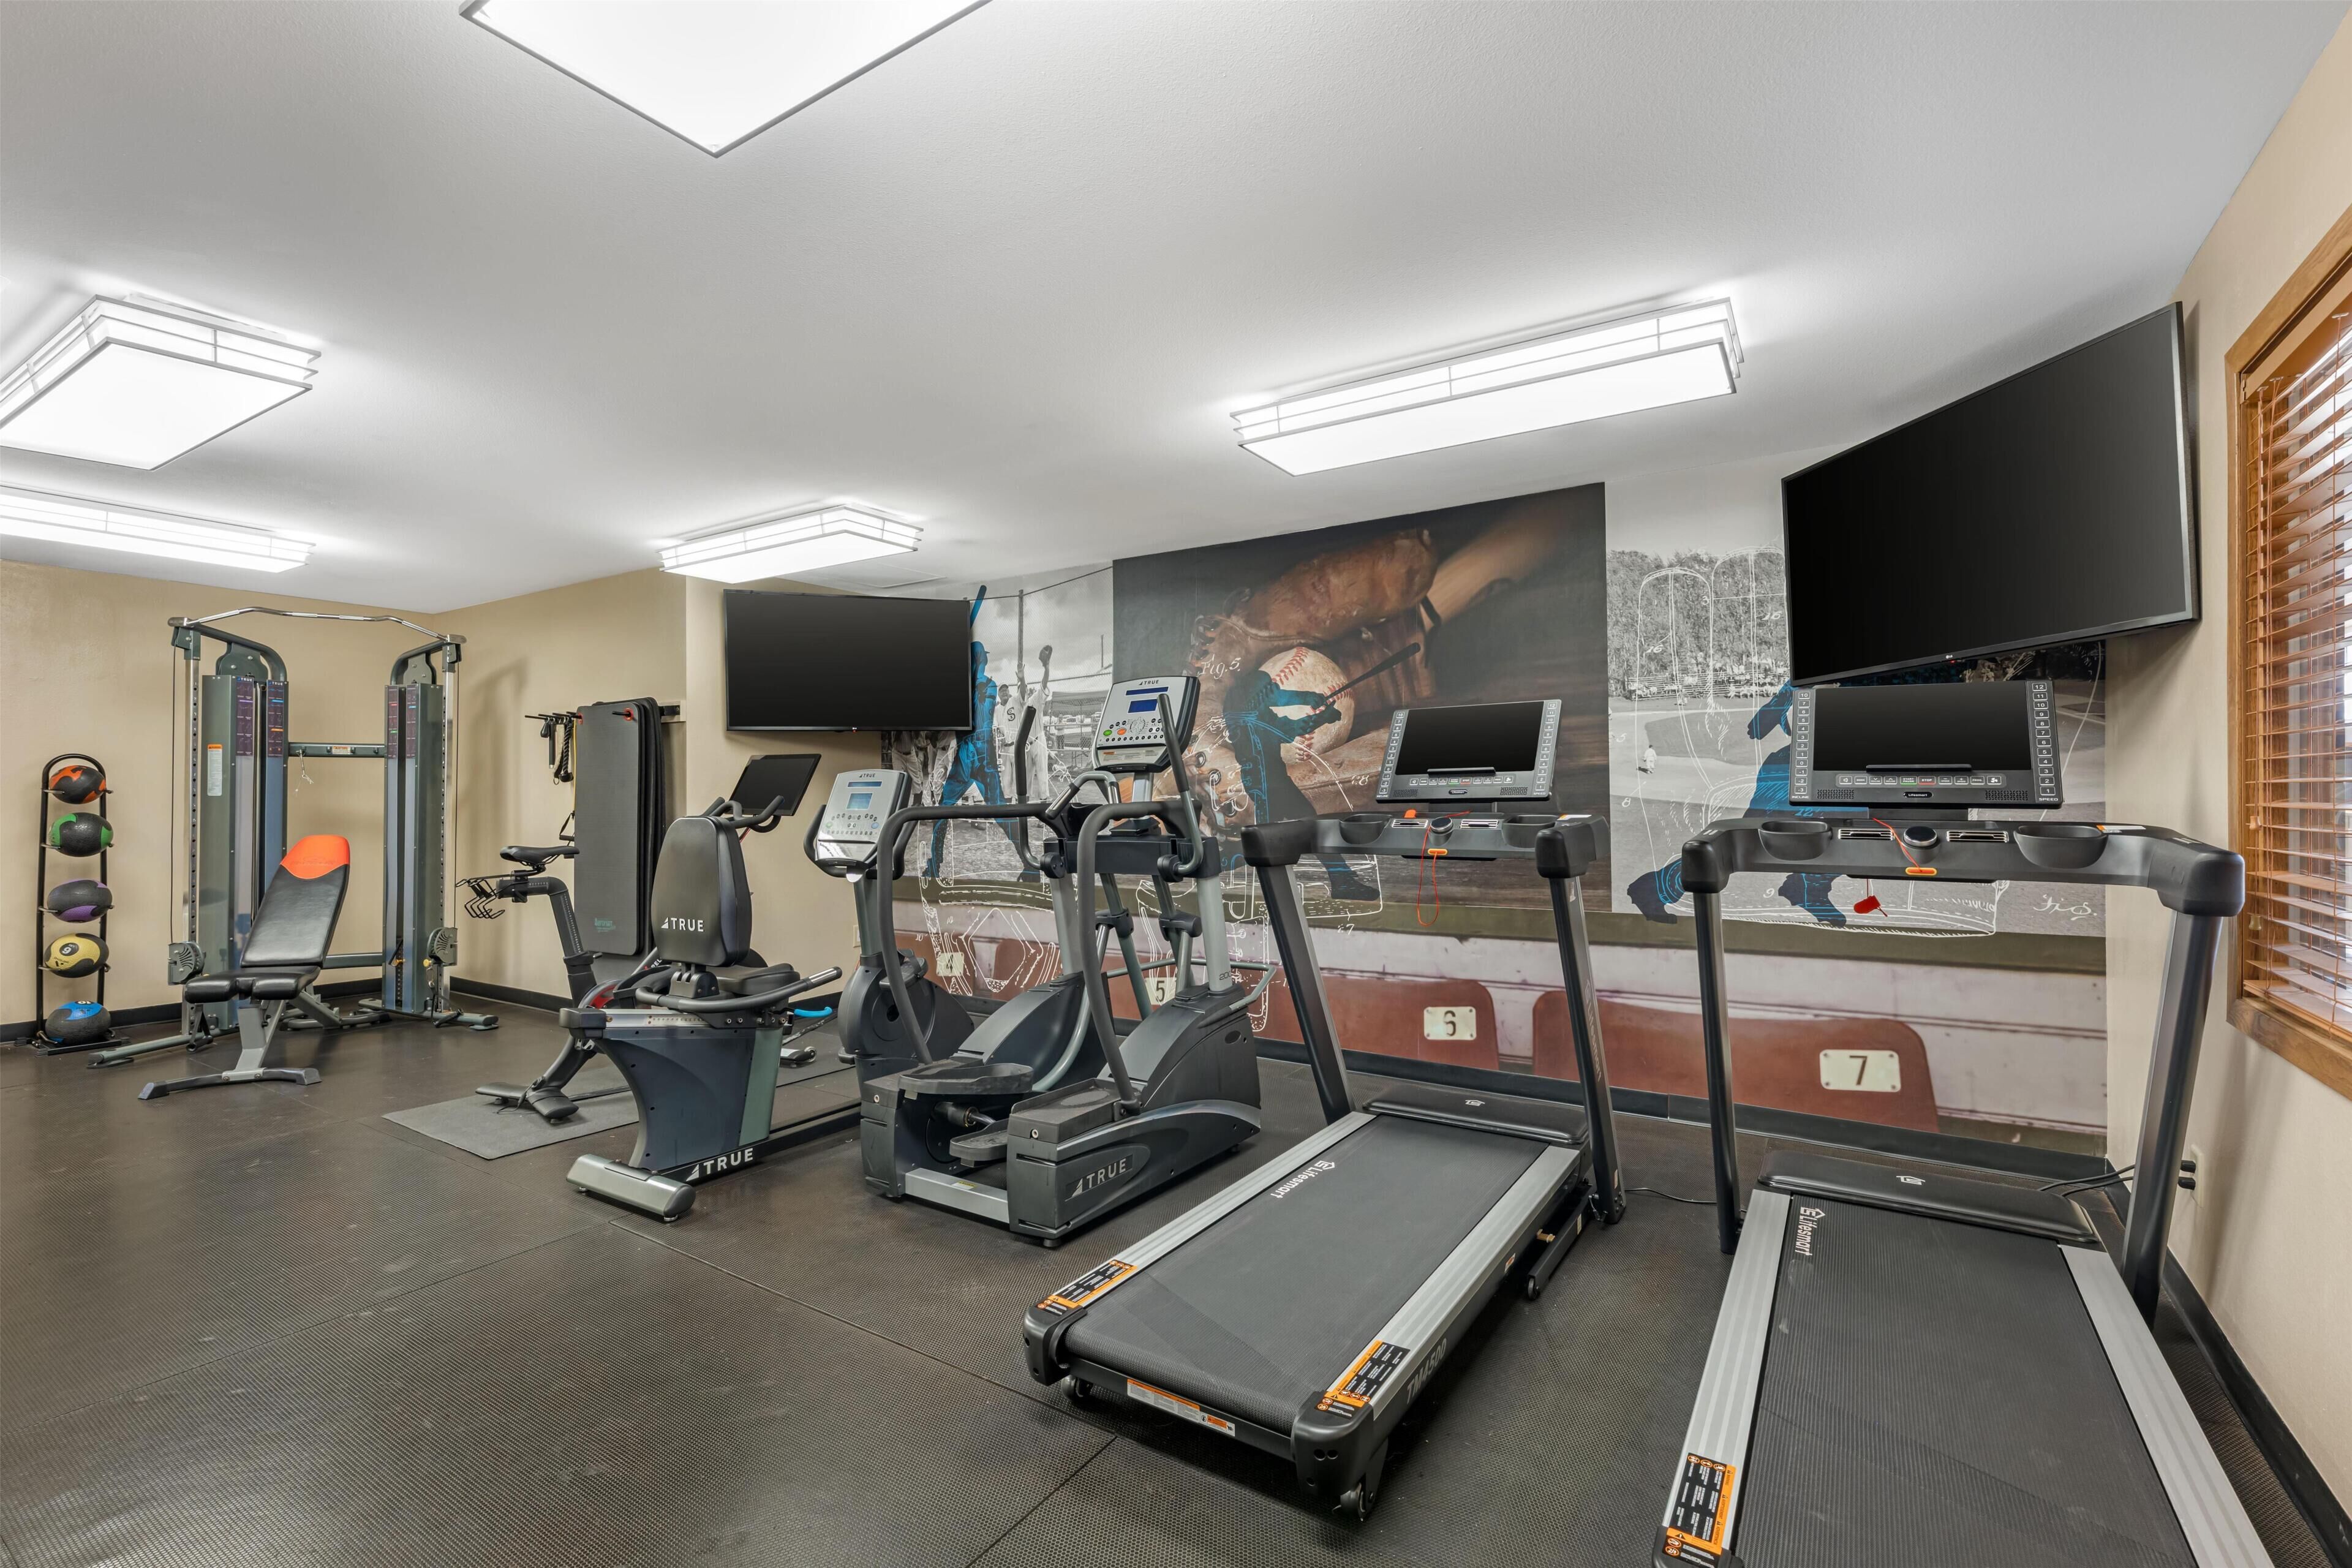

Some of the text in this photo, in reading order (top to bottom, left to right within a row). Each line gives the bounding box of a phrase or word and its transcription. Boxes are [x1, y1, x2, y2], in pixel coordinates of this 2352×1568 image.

[1702, 595, 1709, 605] 3
[1645, 644, 1664, 653] 16
[1622, 797, 1631, 807] 8
[1763, 888, 1774, 898] 9
[671, 918, 704, 932] TRUE
[1156, 980, 1164, 1002] 5
[1444, 1010, 1457, 1036] 6
[1849, 1055, 1868, 1085] 7
[703, 1148, 753, 1175] TRUE
[1086, 1158, 1126, 1188] TRUE
[1270, 1167, 1323, 1198] Lifesmart
[1795, 1215, 1817, 1256] Lifesmart
[1407, 1338, 1447, 1404] TM4500
